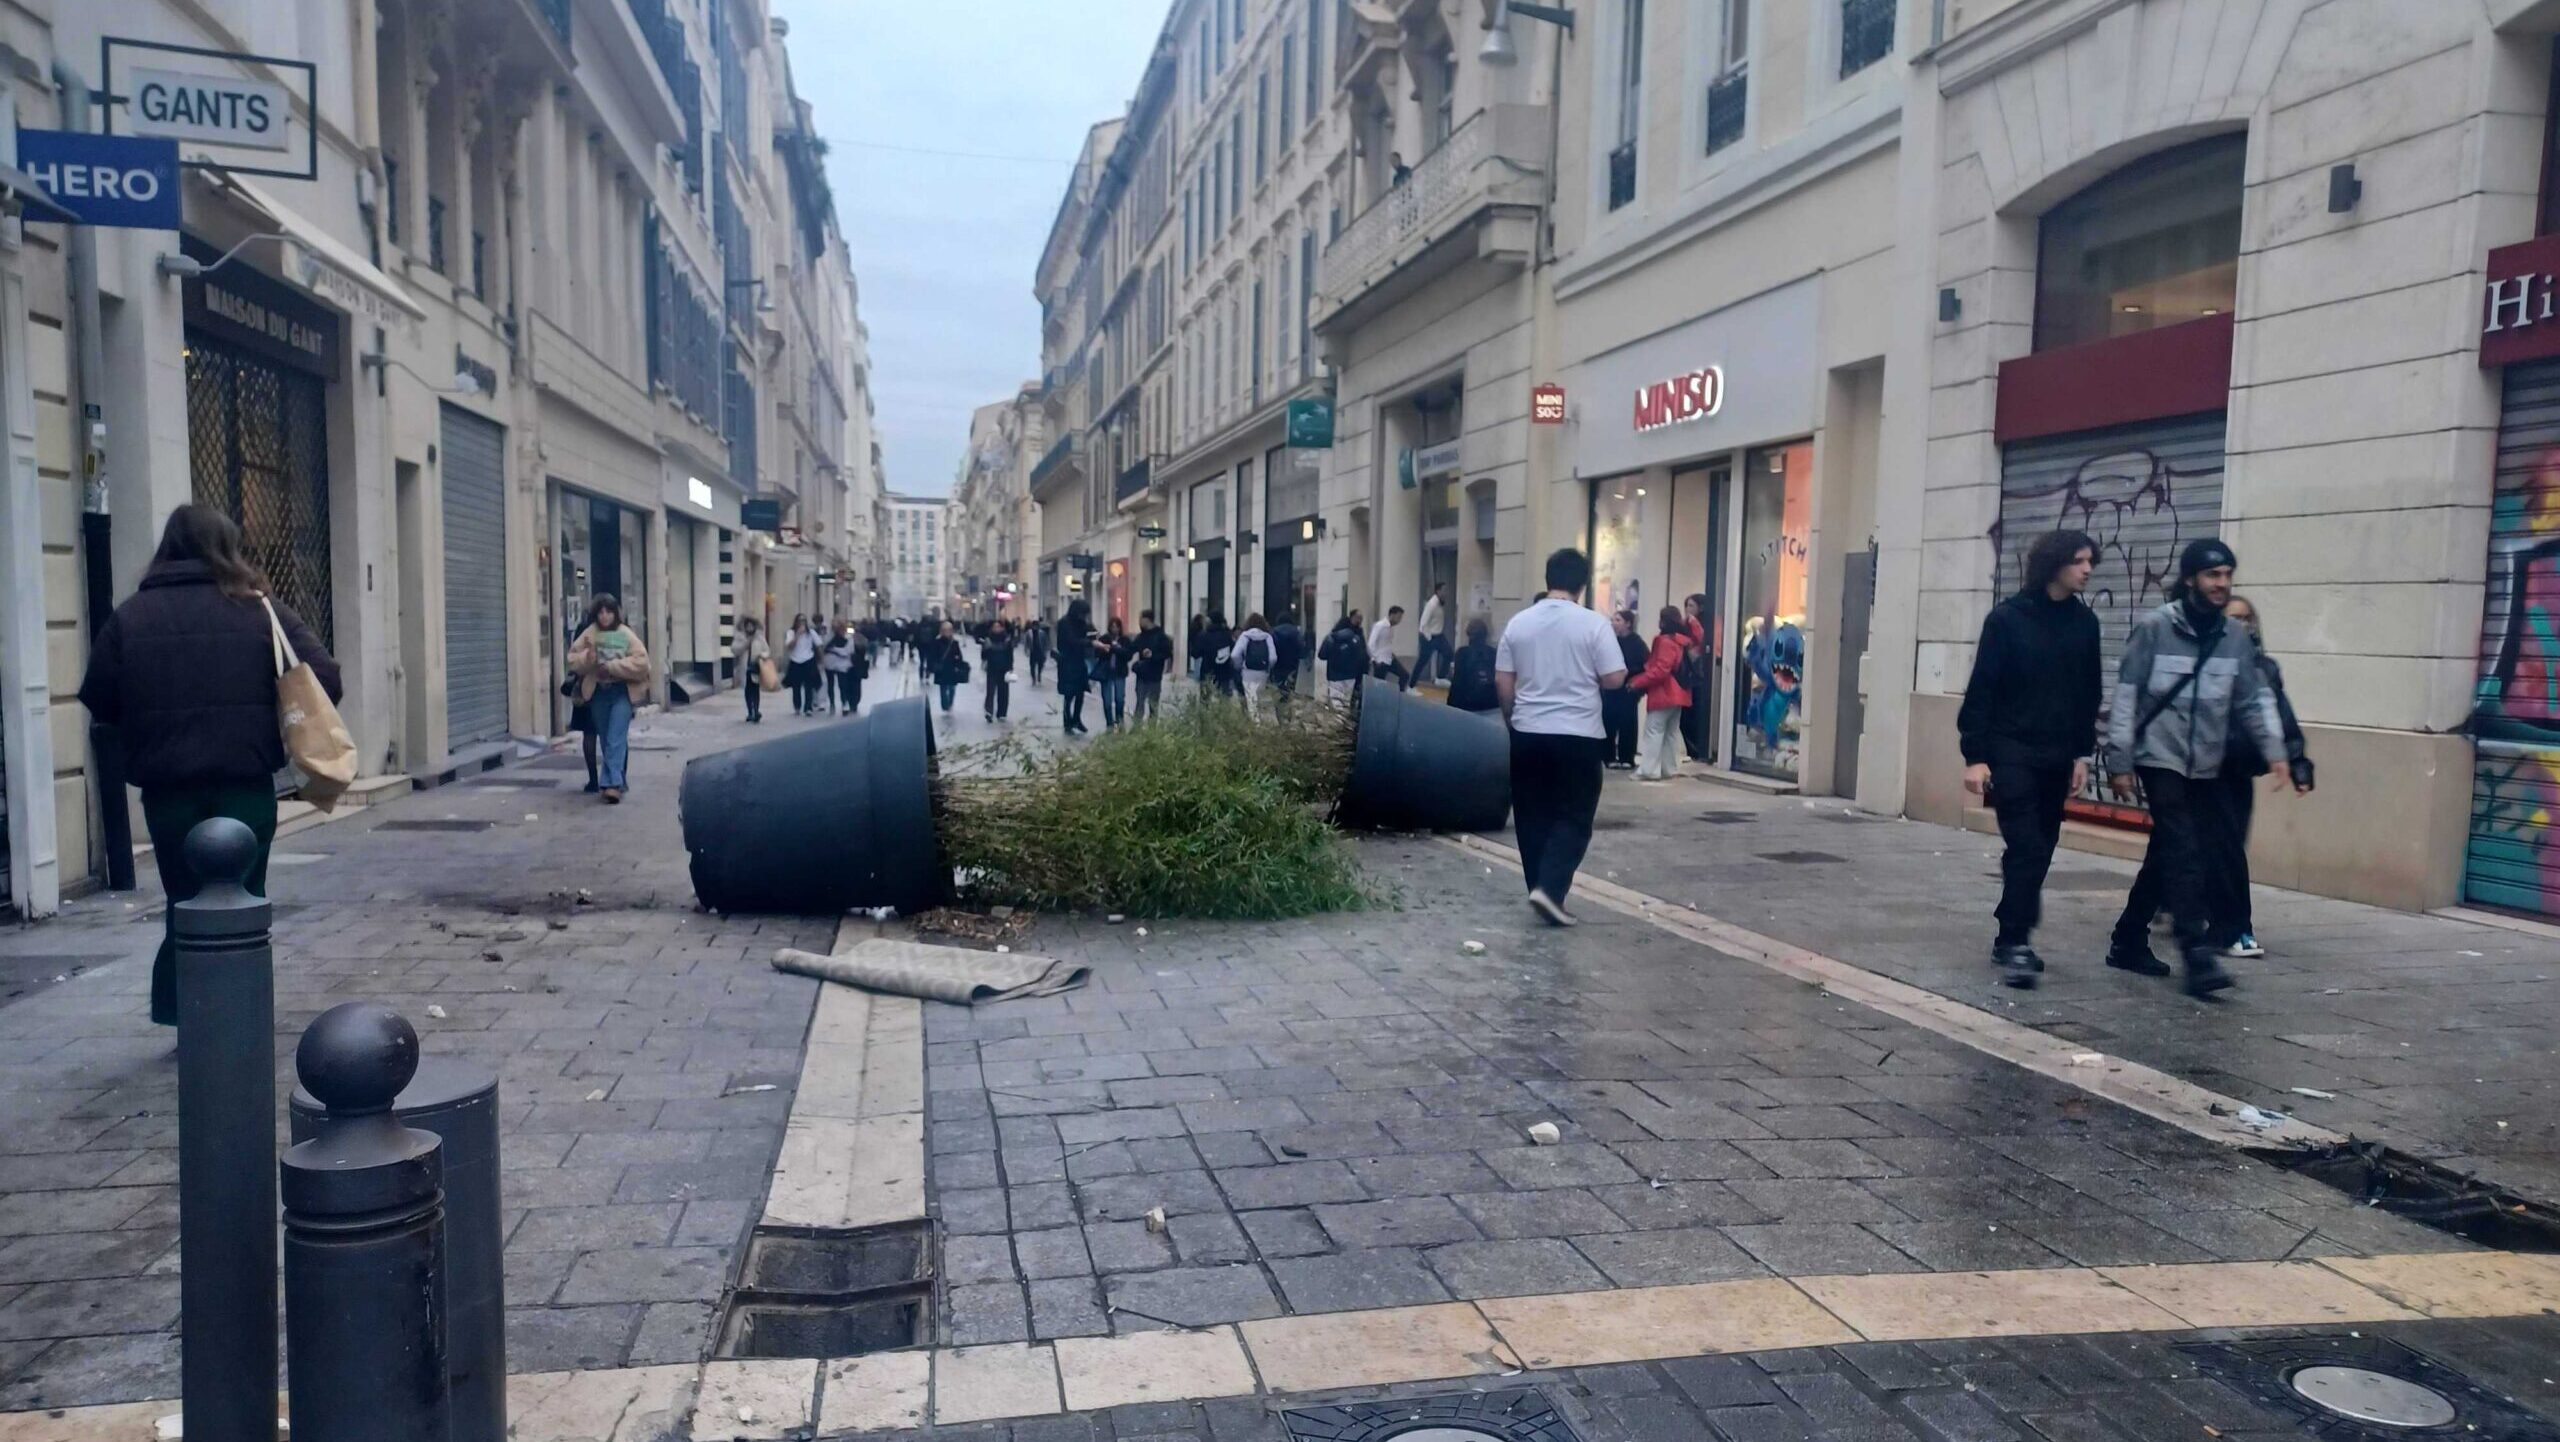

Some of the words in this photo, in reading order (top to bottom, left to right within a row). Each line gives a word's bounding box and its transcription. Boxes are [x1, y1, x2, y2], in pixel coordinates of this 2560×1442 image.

[140, 82, 269, 133] GANTS
[27, 161, 159, 202] HERO
[205, 282, 266, 332] MAISON
[268, 311, 288, 342] DU
[290, 321, 322, 354] GANT
[2484, 273, 2554, 333] Hi
[1536, 394, 1563, 406] MINI
[1633, 366, 1724, 432] MINISO
[1760, 535, 1807, 567] STITCH
